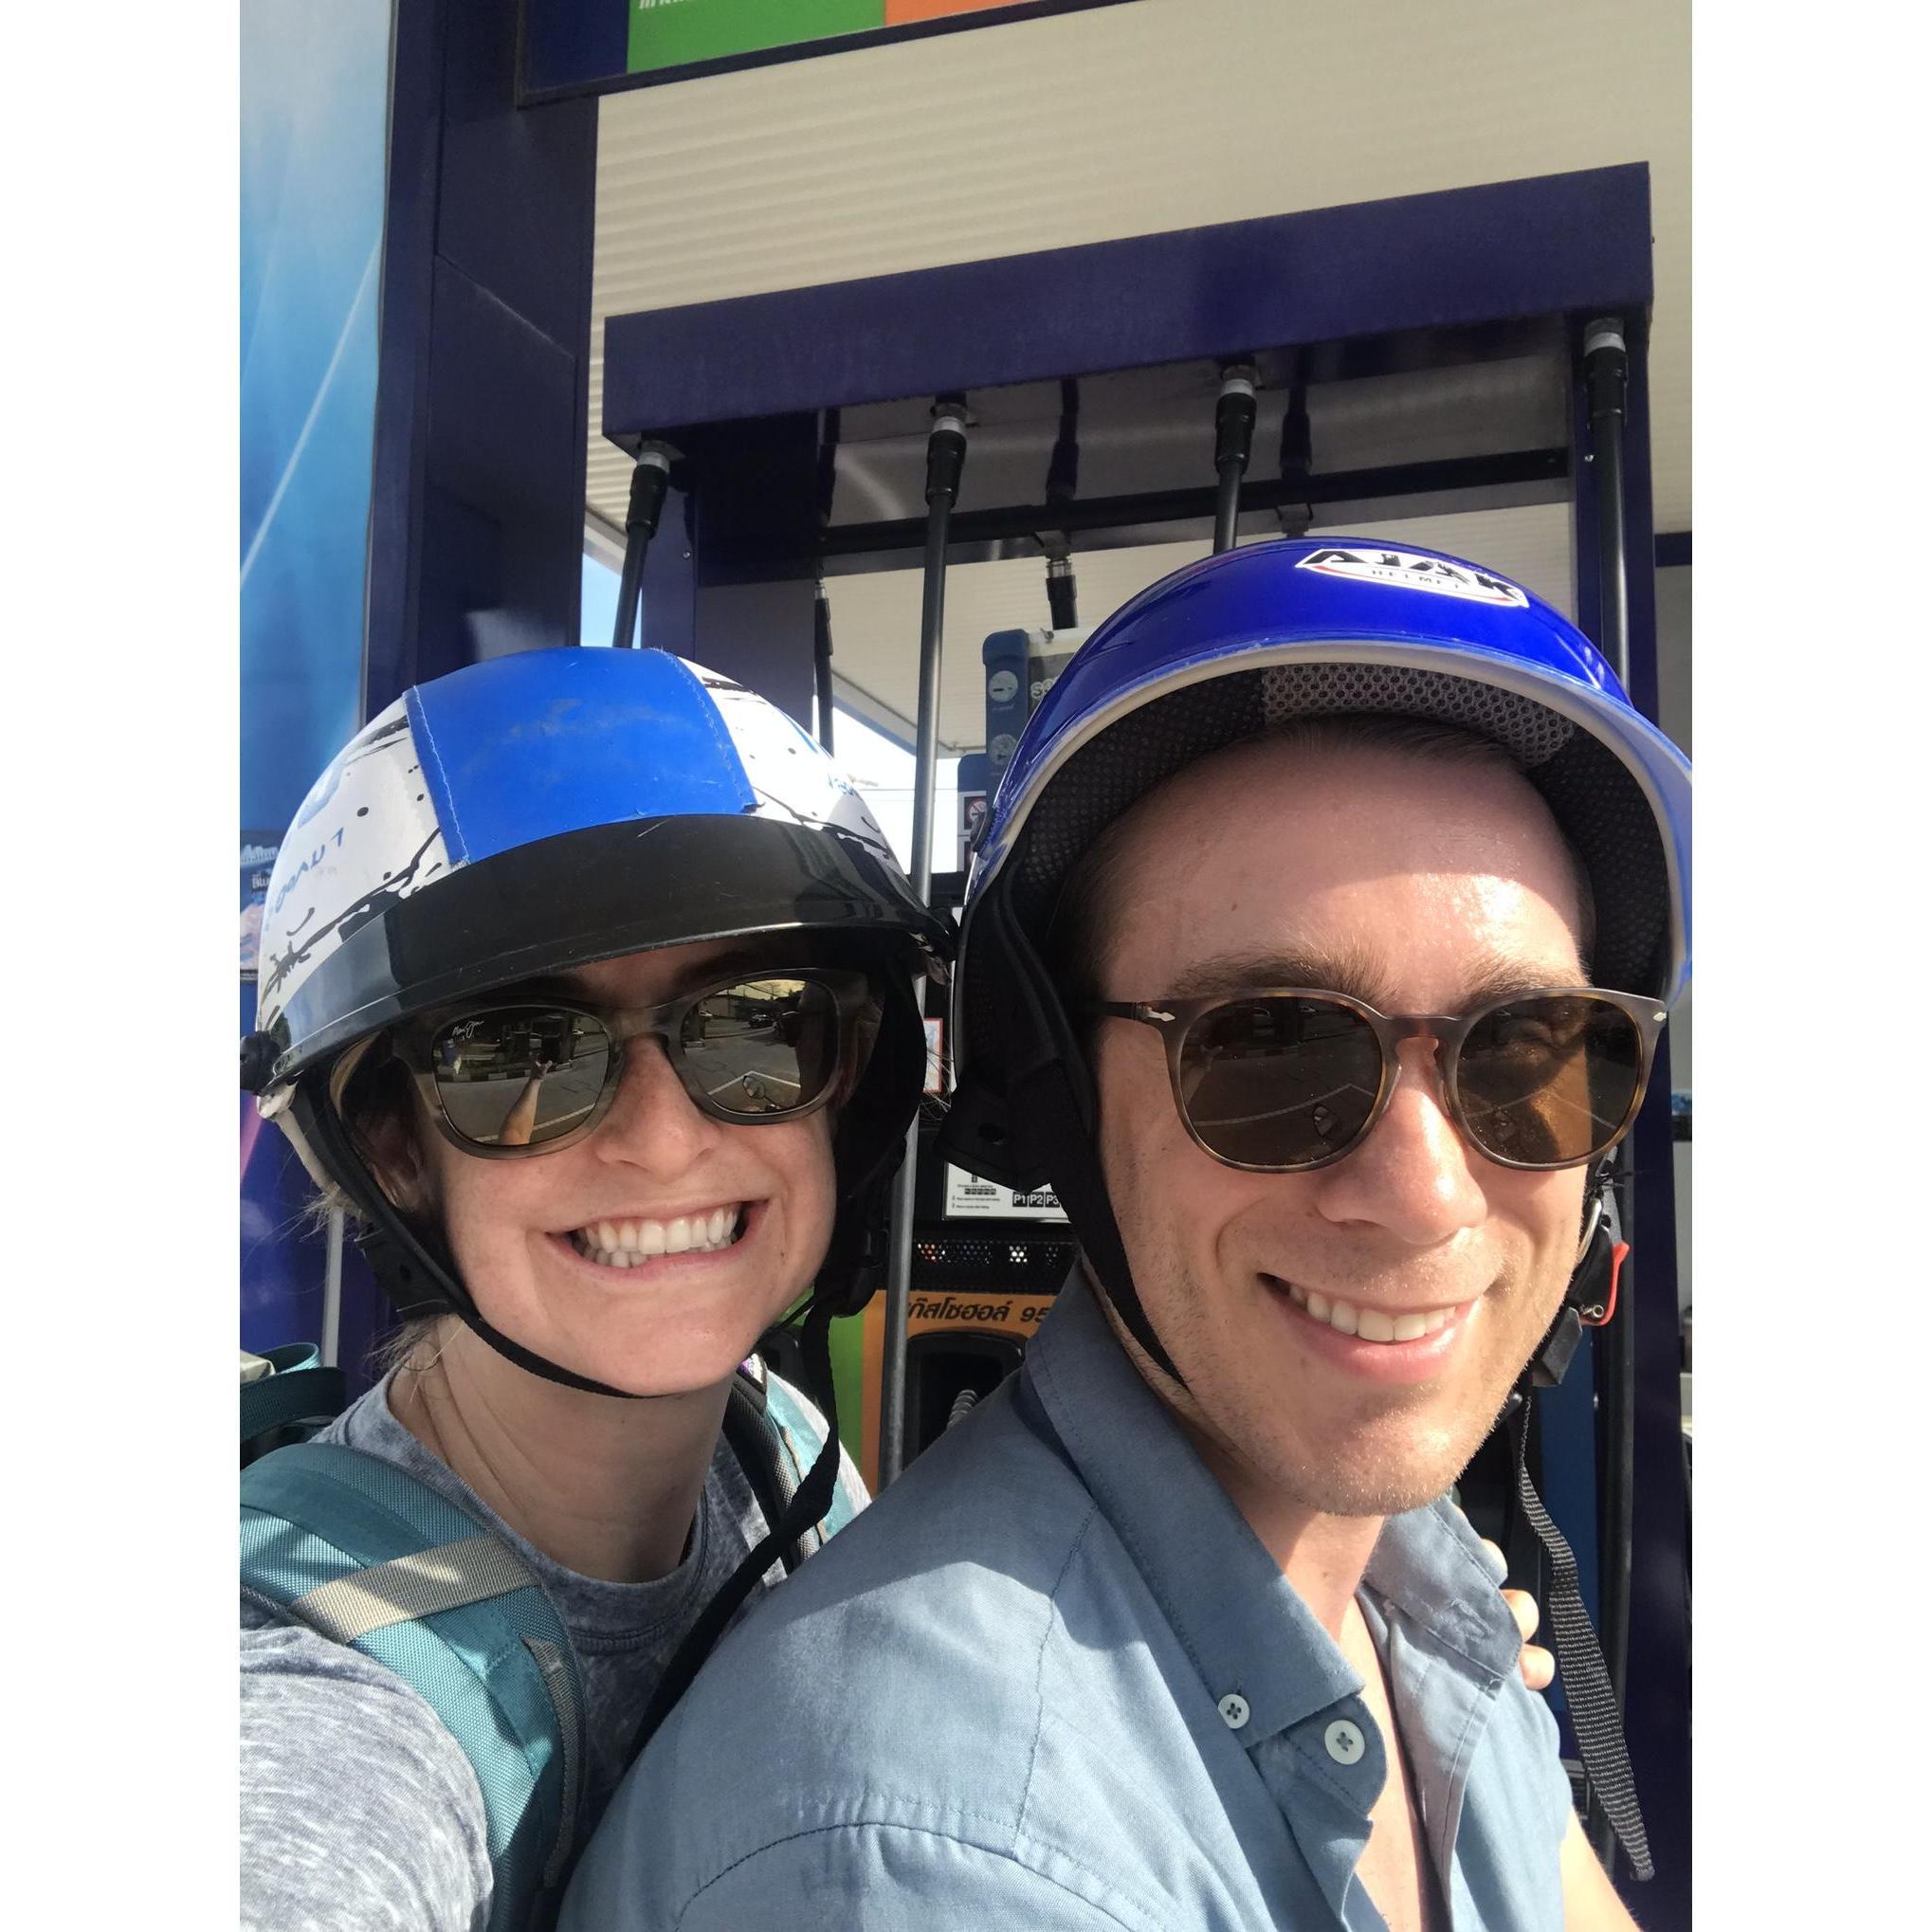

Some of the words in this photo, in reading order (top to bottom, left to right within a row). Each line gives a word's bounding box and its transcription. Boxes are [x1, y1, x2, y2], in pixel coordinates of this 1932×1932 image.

[1013, 1194, 1027, 1205] P1
[1030, 1194, 1044, 1205] P2
[1046, 1194, 1060, 1206] P3
